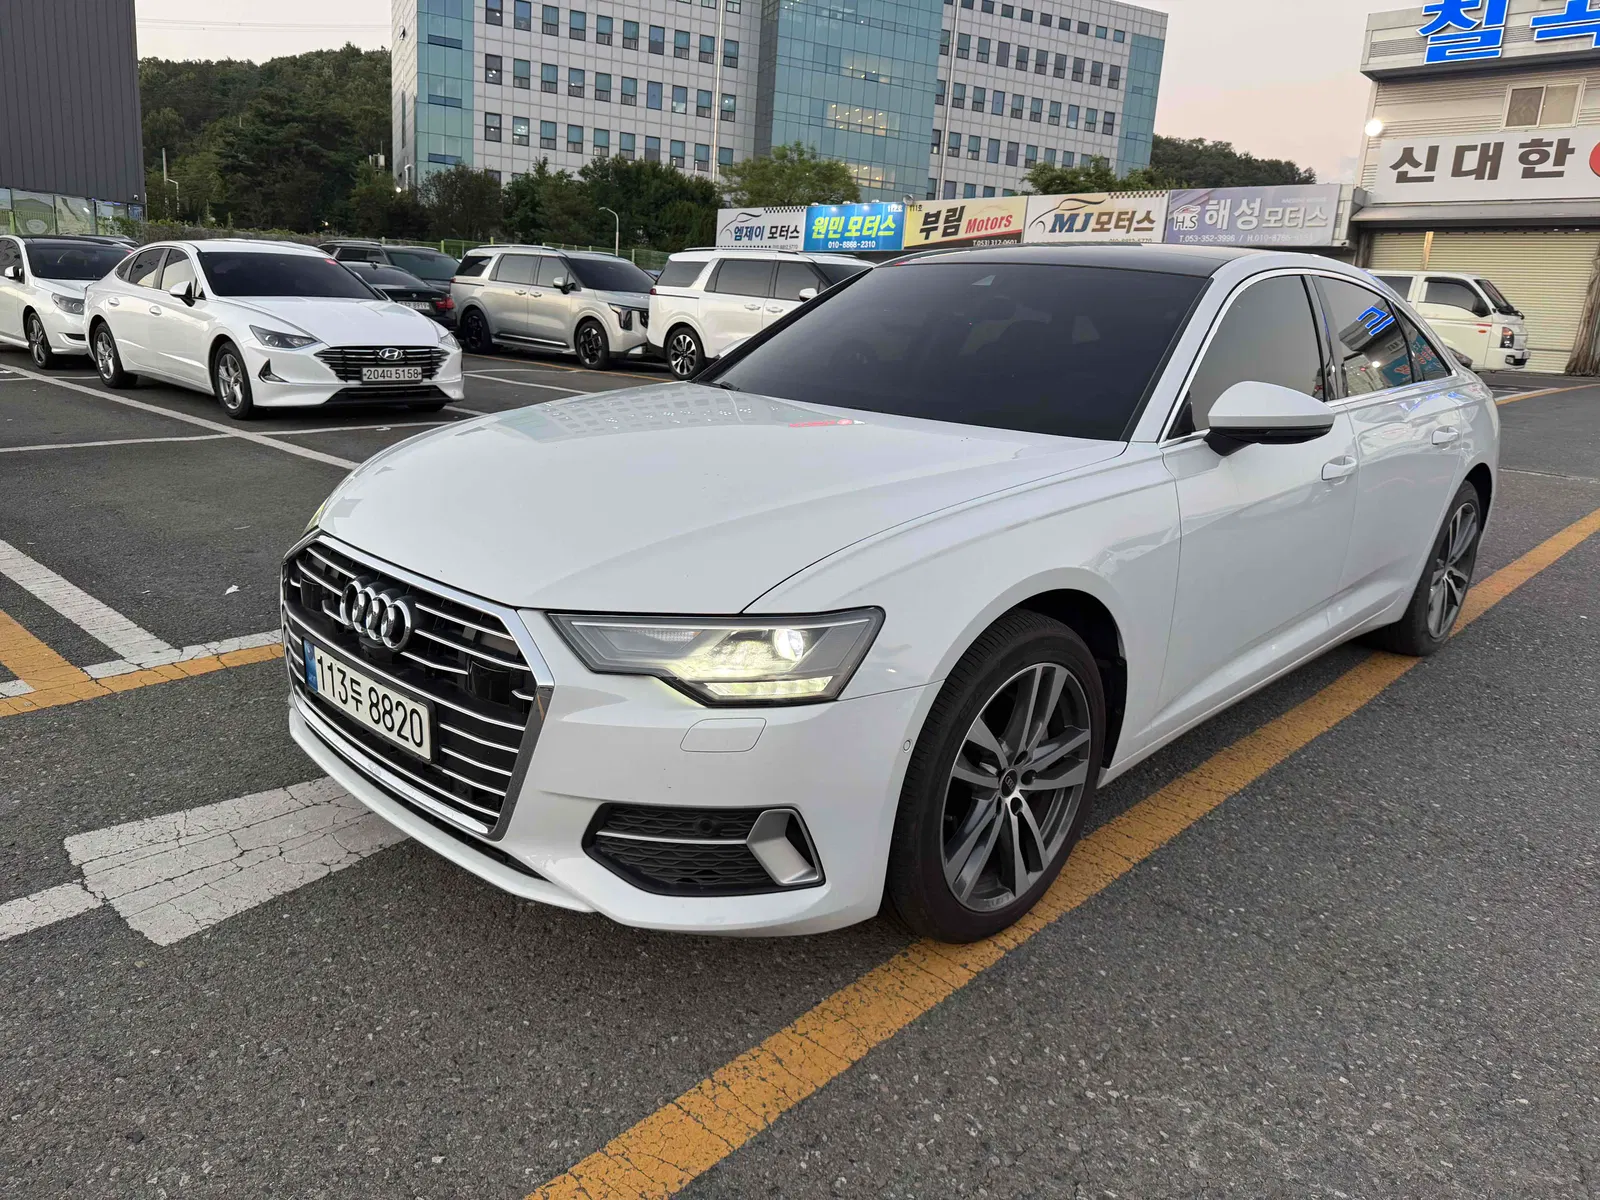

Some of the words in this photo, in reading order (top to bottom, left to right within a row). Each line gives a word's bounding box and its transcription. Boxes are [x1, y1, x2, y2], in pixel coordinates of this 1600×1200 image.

[1389, 137, 1576, 184] 신대한
[733, 225, 765, 241] 엠제이
[767, 225, 800, 240] 모터스
[812, 216, 845, 239] 원민
[844, 214, 896, 238] 모터스
[919, 205, 967, 240] 부림
[965, 214, 1013, 234] Motors
[1173, 213, 1198, 230] H.S
[394, 368, 419, 379] 5158
[317, 655, 363, 712] 113두
[368, 686, 424, 748] 8820
